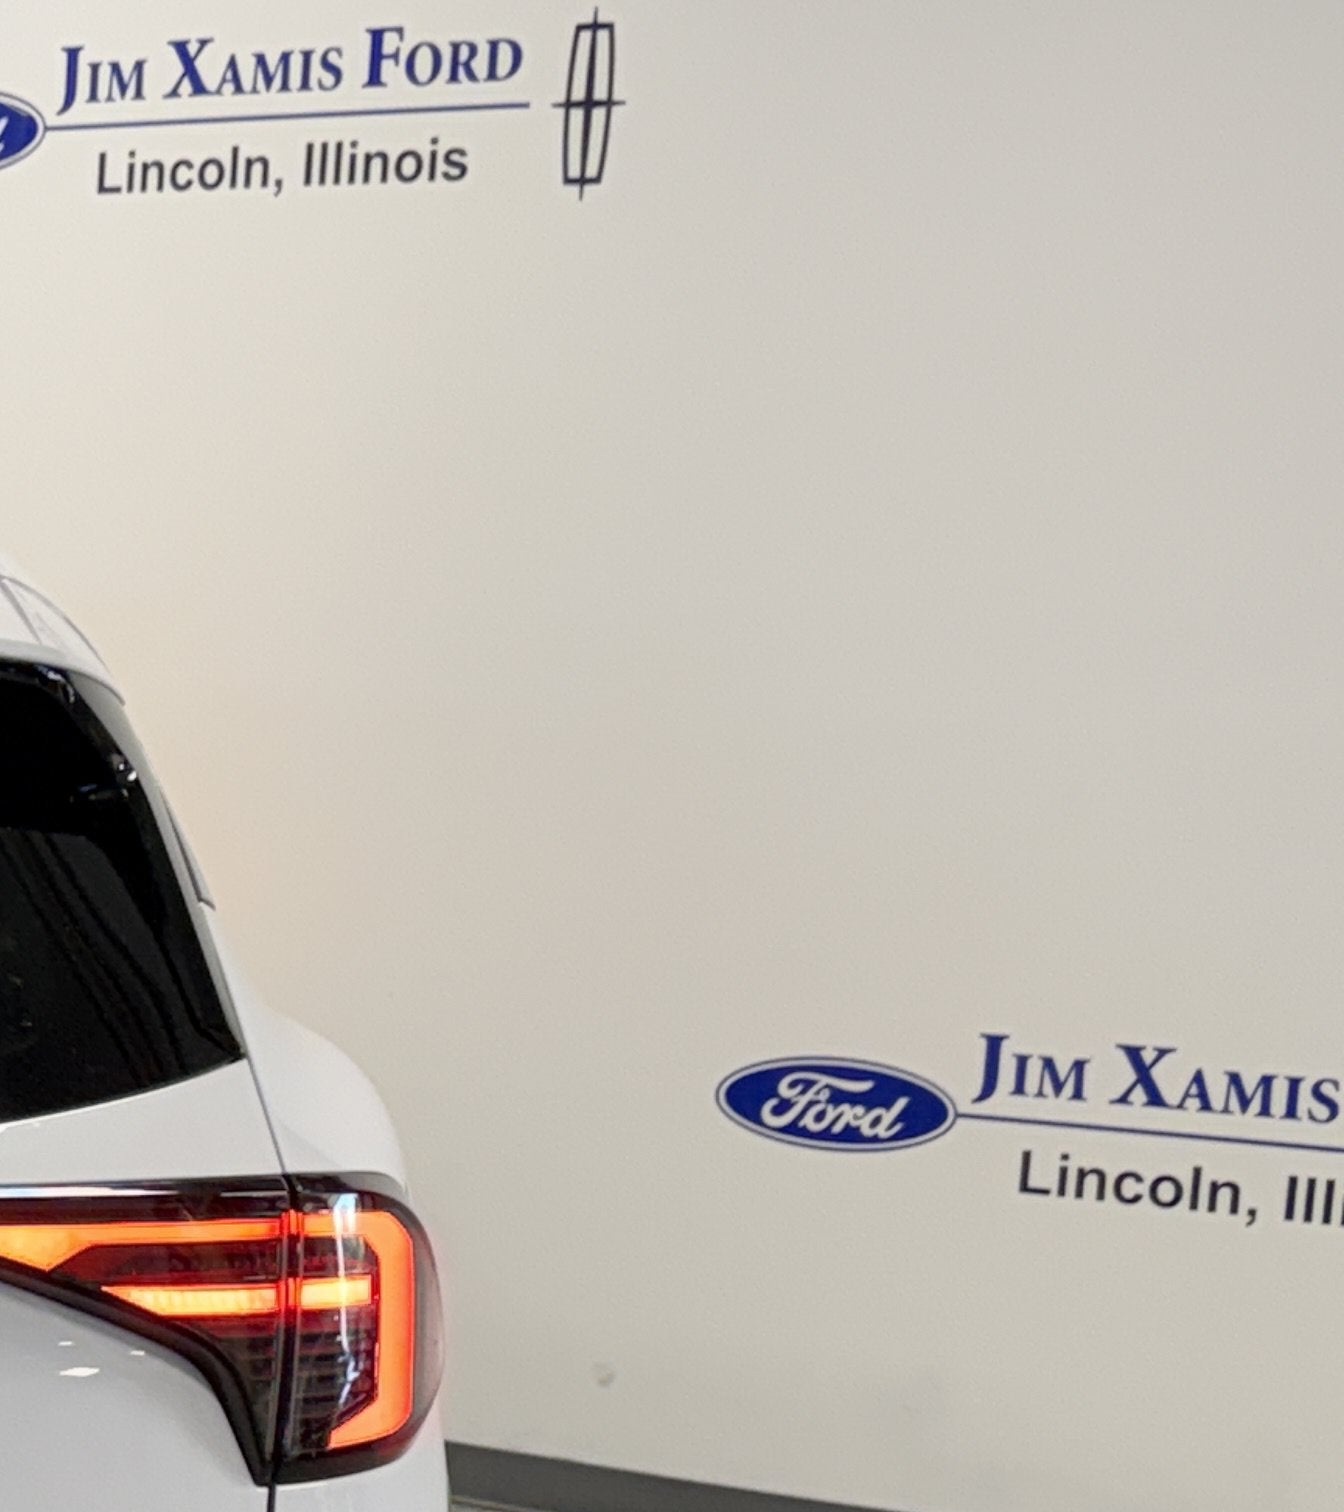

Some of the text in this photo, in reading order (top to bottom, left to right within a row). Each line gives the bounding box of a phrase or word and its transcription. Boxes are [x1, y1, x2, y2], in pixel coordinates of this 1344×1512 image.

[56, 27, 523, 116] JIM XAMIS FORD
[97, 137, 468, 196] Lincoln, Illinois
[760, 1070, 910, 1140] Ford
[972, 1033, 1340, 1123] JIM XAMIS
[1018, 1149, 1259, 1227] Lincoln,
